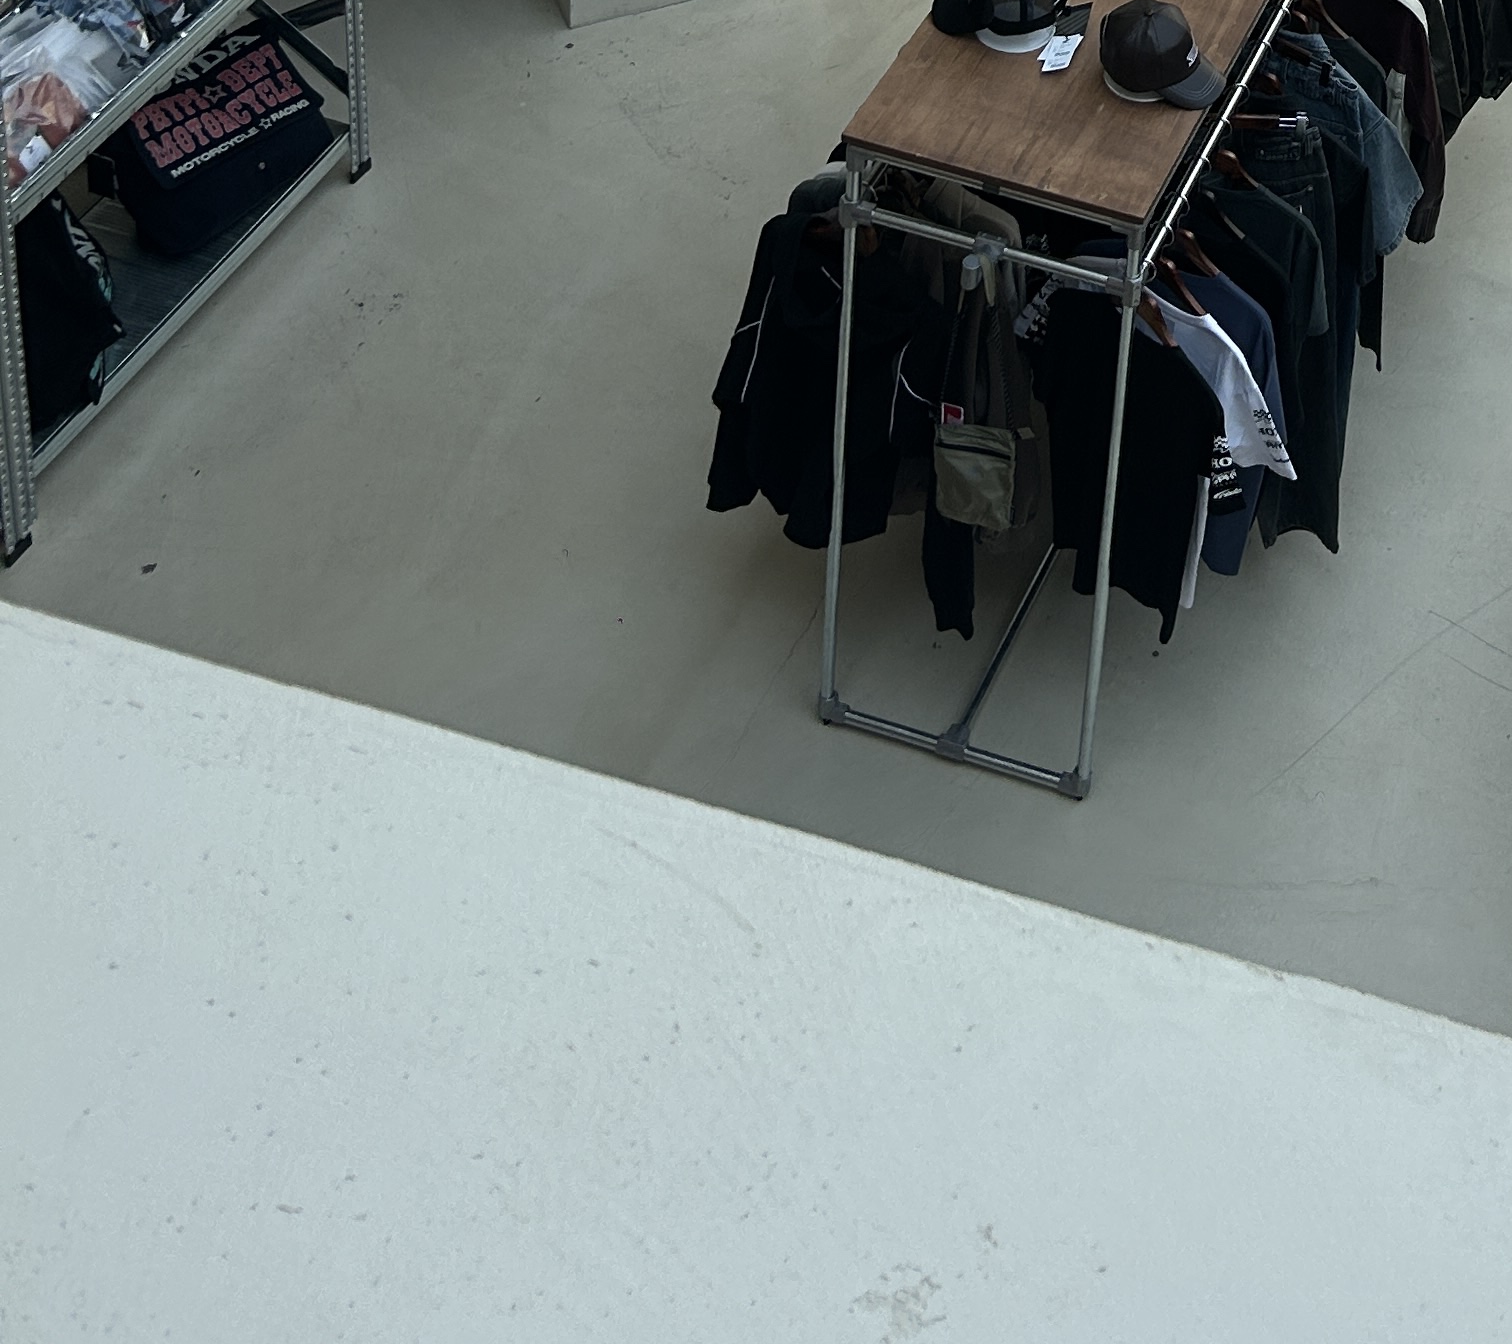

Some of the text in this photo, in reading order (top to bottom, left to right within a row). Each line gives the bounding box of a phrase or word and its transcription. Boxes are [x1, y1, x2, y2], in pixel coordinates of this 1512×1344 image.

[216, 43, 282, 93] DEPT
[145, 69, 303, 169] MOTORCYCLE
[170, 98, 311, 179] MOTORCYCLE RACING
